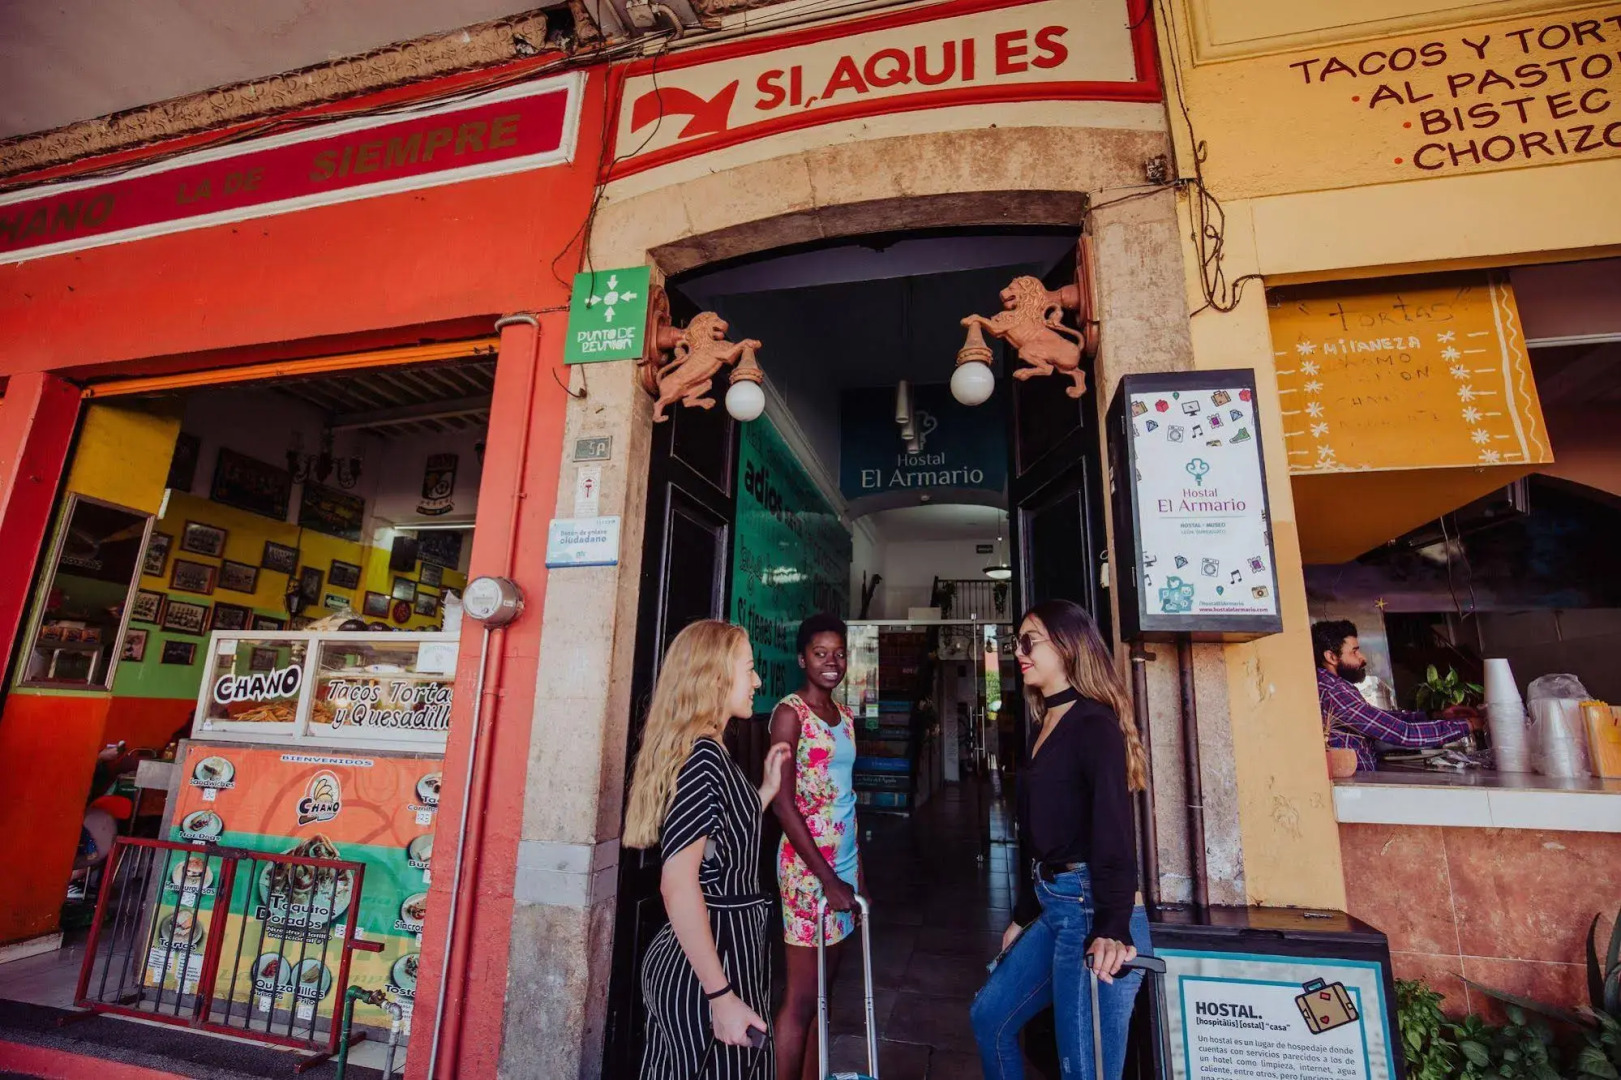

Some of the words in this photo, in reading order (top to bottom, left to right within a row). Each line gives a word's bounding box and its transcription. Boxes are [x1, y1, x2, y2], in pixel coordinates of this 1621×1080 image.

[820, 37, 975, 100] AQUI
[995, 25, 1070, 76] ES
[1289, 42, 1447, 84] TACOS
[1461, 35, 1491, 60] Y
[1369, 80, 1434, 110] AL
[1446, 50, 1621, 99] PASTO
[1419, 86, 1611, 136] BISTEC
[176, 176, 213, 205] LA
[222, 167, 265, 195] DE
[309, 114, 521, 182] SIEMPRE
[576, 329, 617, 343] PUNTO
[618, 326, 637, 339] DE
[897, 452, 945, 467] Hostal
[861, 469, 881, 488] El
[889, 466, 984, 487] Armario
[1182, 488, 1218, 498] Hostal
[1157, 499, 1172, 513] El
[1179, 497, 1246, 512] Armario
[560, 535, 607, 545] ciudadano
[215, 667, 300, 703] CHANO
[329, 681, 381, 703] Tacos
[331, 708, 347, 730] y
[351, 703, 449, 729] Quesadill
[281, 755, 374, 767] BIENVENIDOS
[299, 797, 340, 814] CHANO
[1196, 1001, 1263, 1020] HOSTAL.
[1239, 1019, 1265, 1031] [ostal]
[1197, 1035, 1208, 1043] Un
[1209, 1036, 1232, 1045] hostal
[1255, 1039, 1274, 1050] lugar
[1276, 1041, 1286, 1049] de
[1287, 1042, 1327, 1053] hospedaje
[1328, 1045, 1354, 1055] donde
[1198, 1045, 1228, 1054] cuentas
[1246, 1049, 1280, 1059] servicios
[1282, 1052, 1320, 1063] parecidos
[1330, 1056, 1342, 1064] los
[1345, 1057, 1355, 1065] de
[1200, 1065, 1233, 1075] caliente,
[1234, 1068, 1255, 1077] entre
[1255, 1070, 1280, 1079] otros,
[1212, 1056, 1233, 1065] hotel
[1236, 1059, 1257, 1067] como
[1260, 1059, 1295, 1071] limpieza,
[1337, 1067, 1357, 1077] agua
